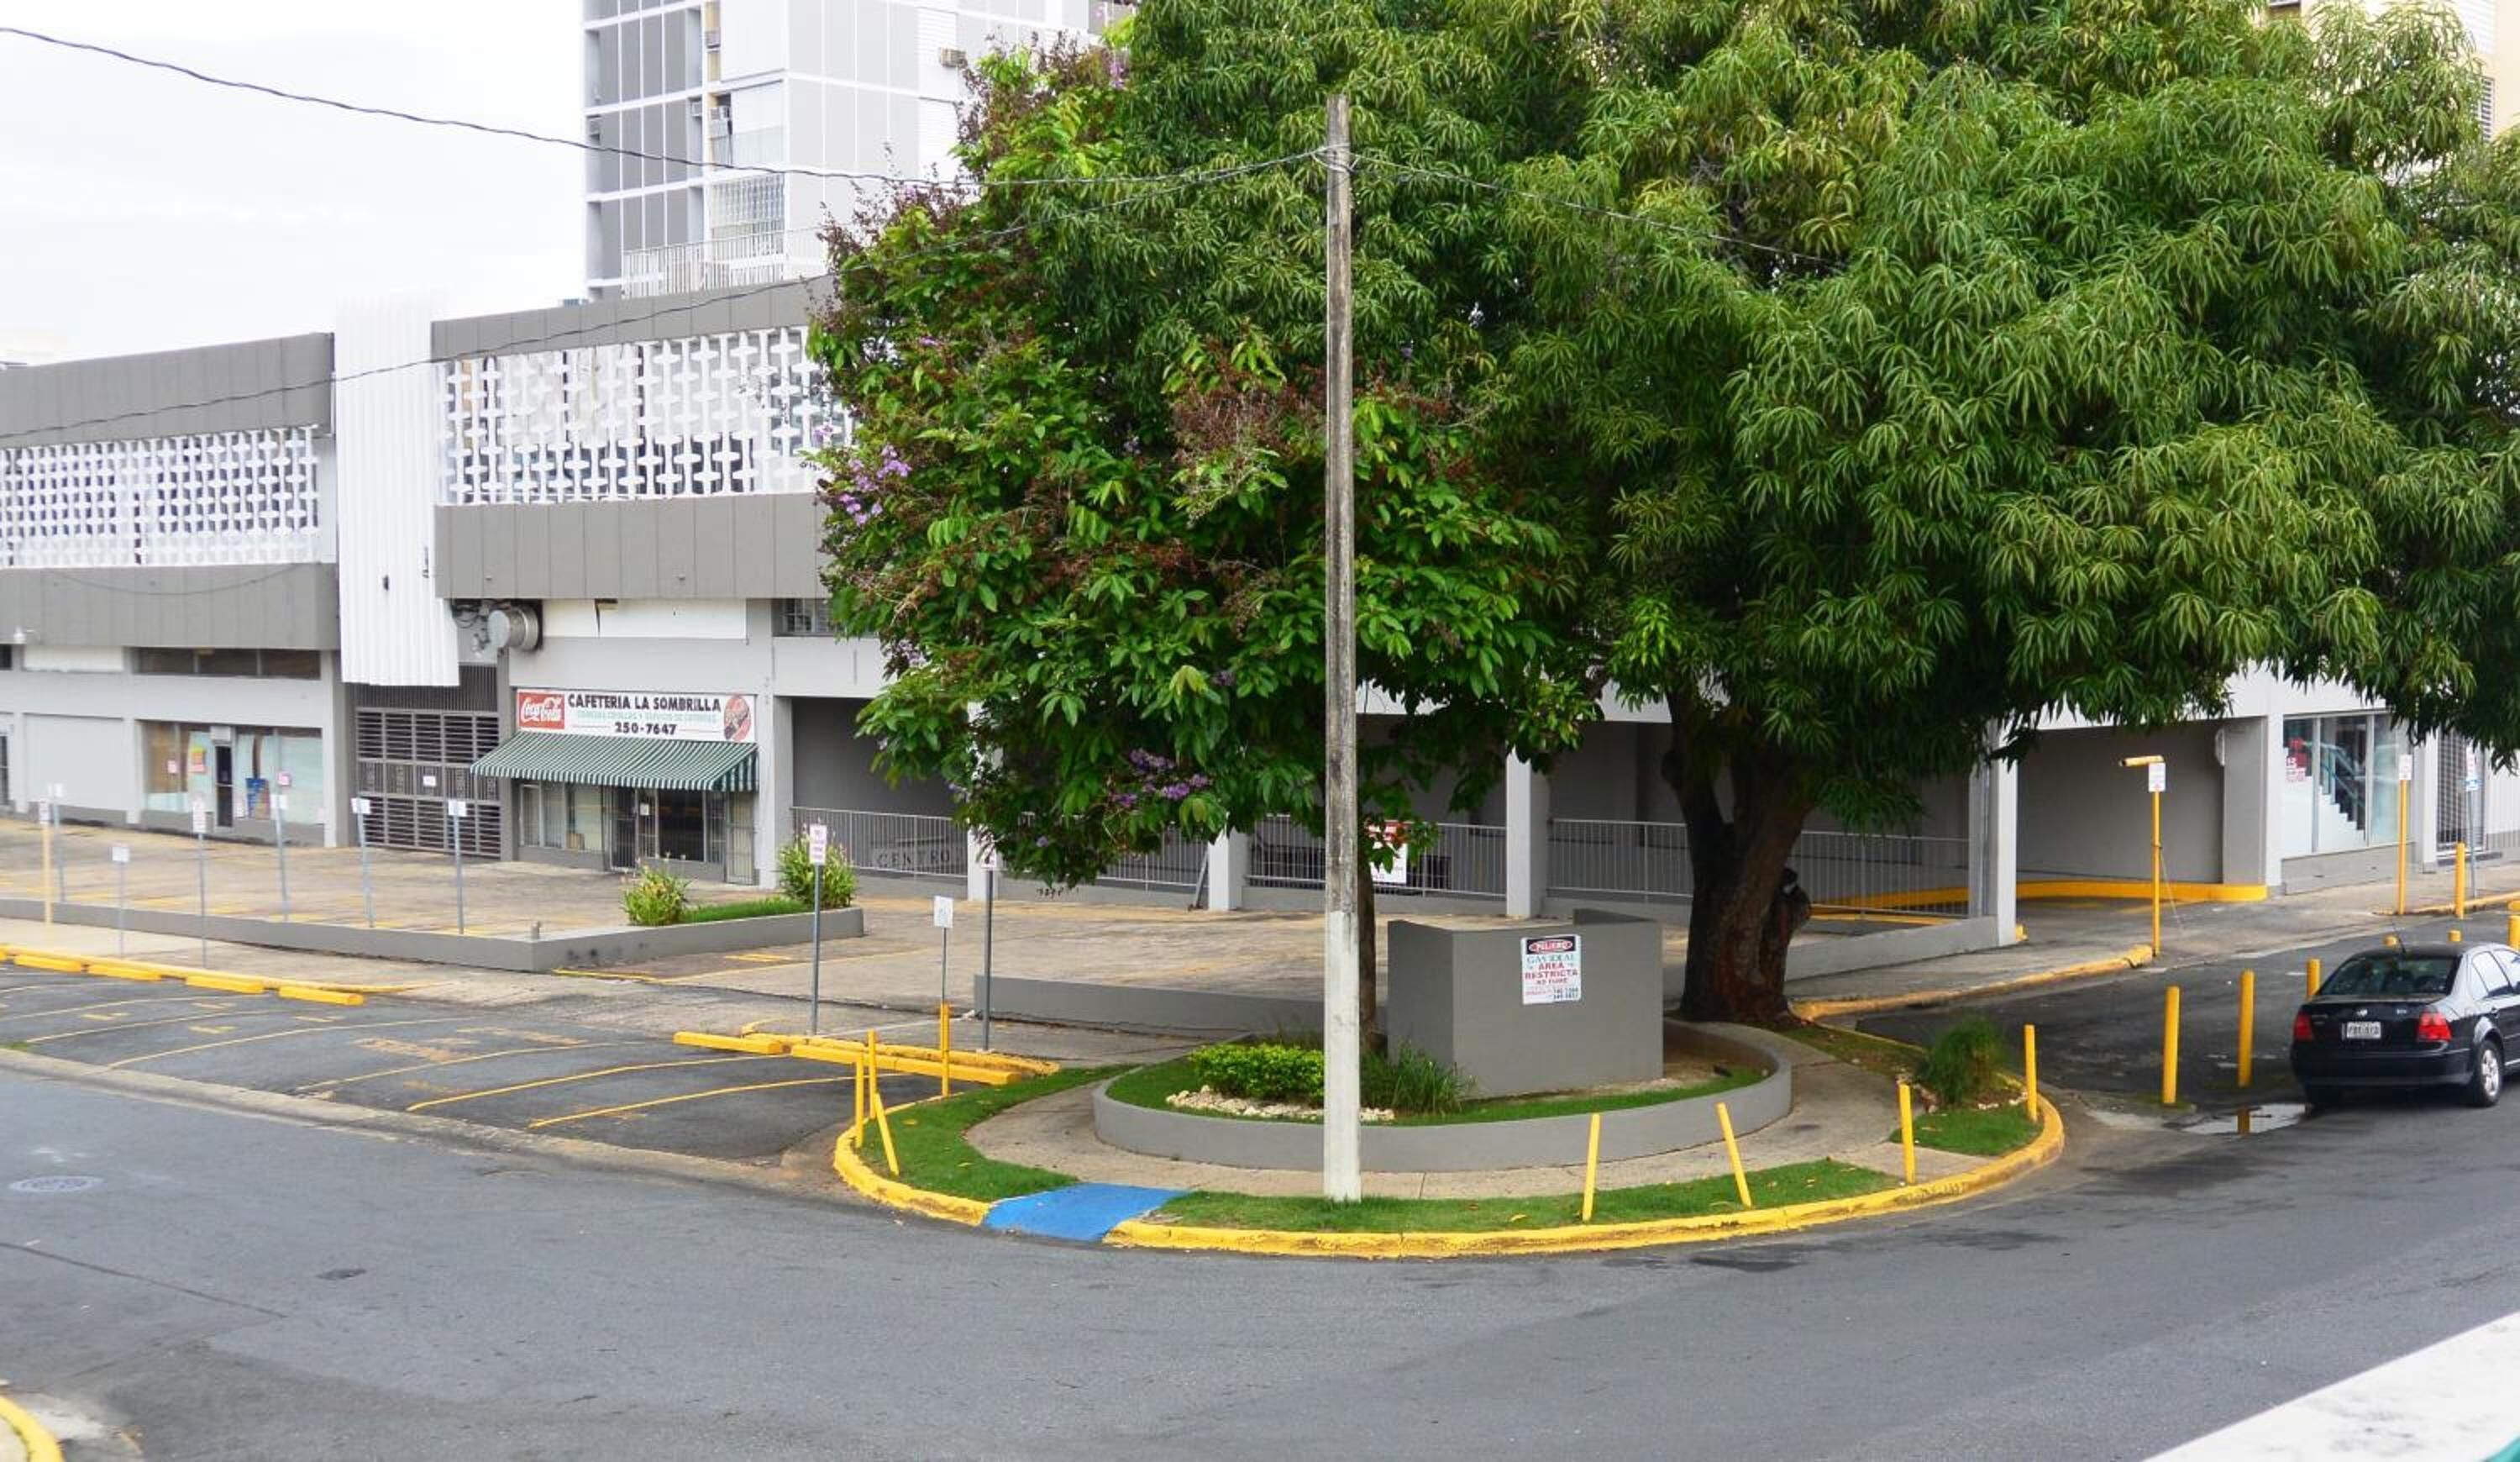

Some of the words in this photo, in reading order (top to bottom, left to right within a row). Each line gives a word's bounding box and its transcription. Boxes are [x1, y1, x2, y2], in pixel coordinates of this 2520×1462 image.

[568, 694, 630, 709] CAFETERIA
[635, 696, 649, 709] LA
[653, 697, 721, 712] SOMBRILLA
[614, 722, 677, 735] 250-7647
[1538, 962, 1565, 970] AREA
